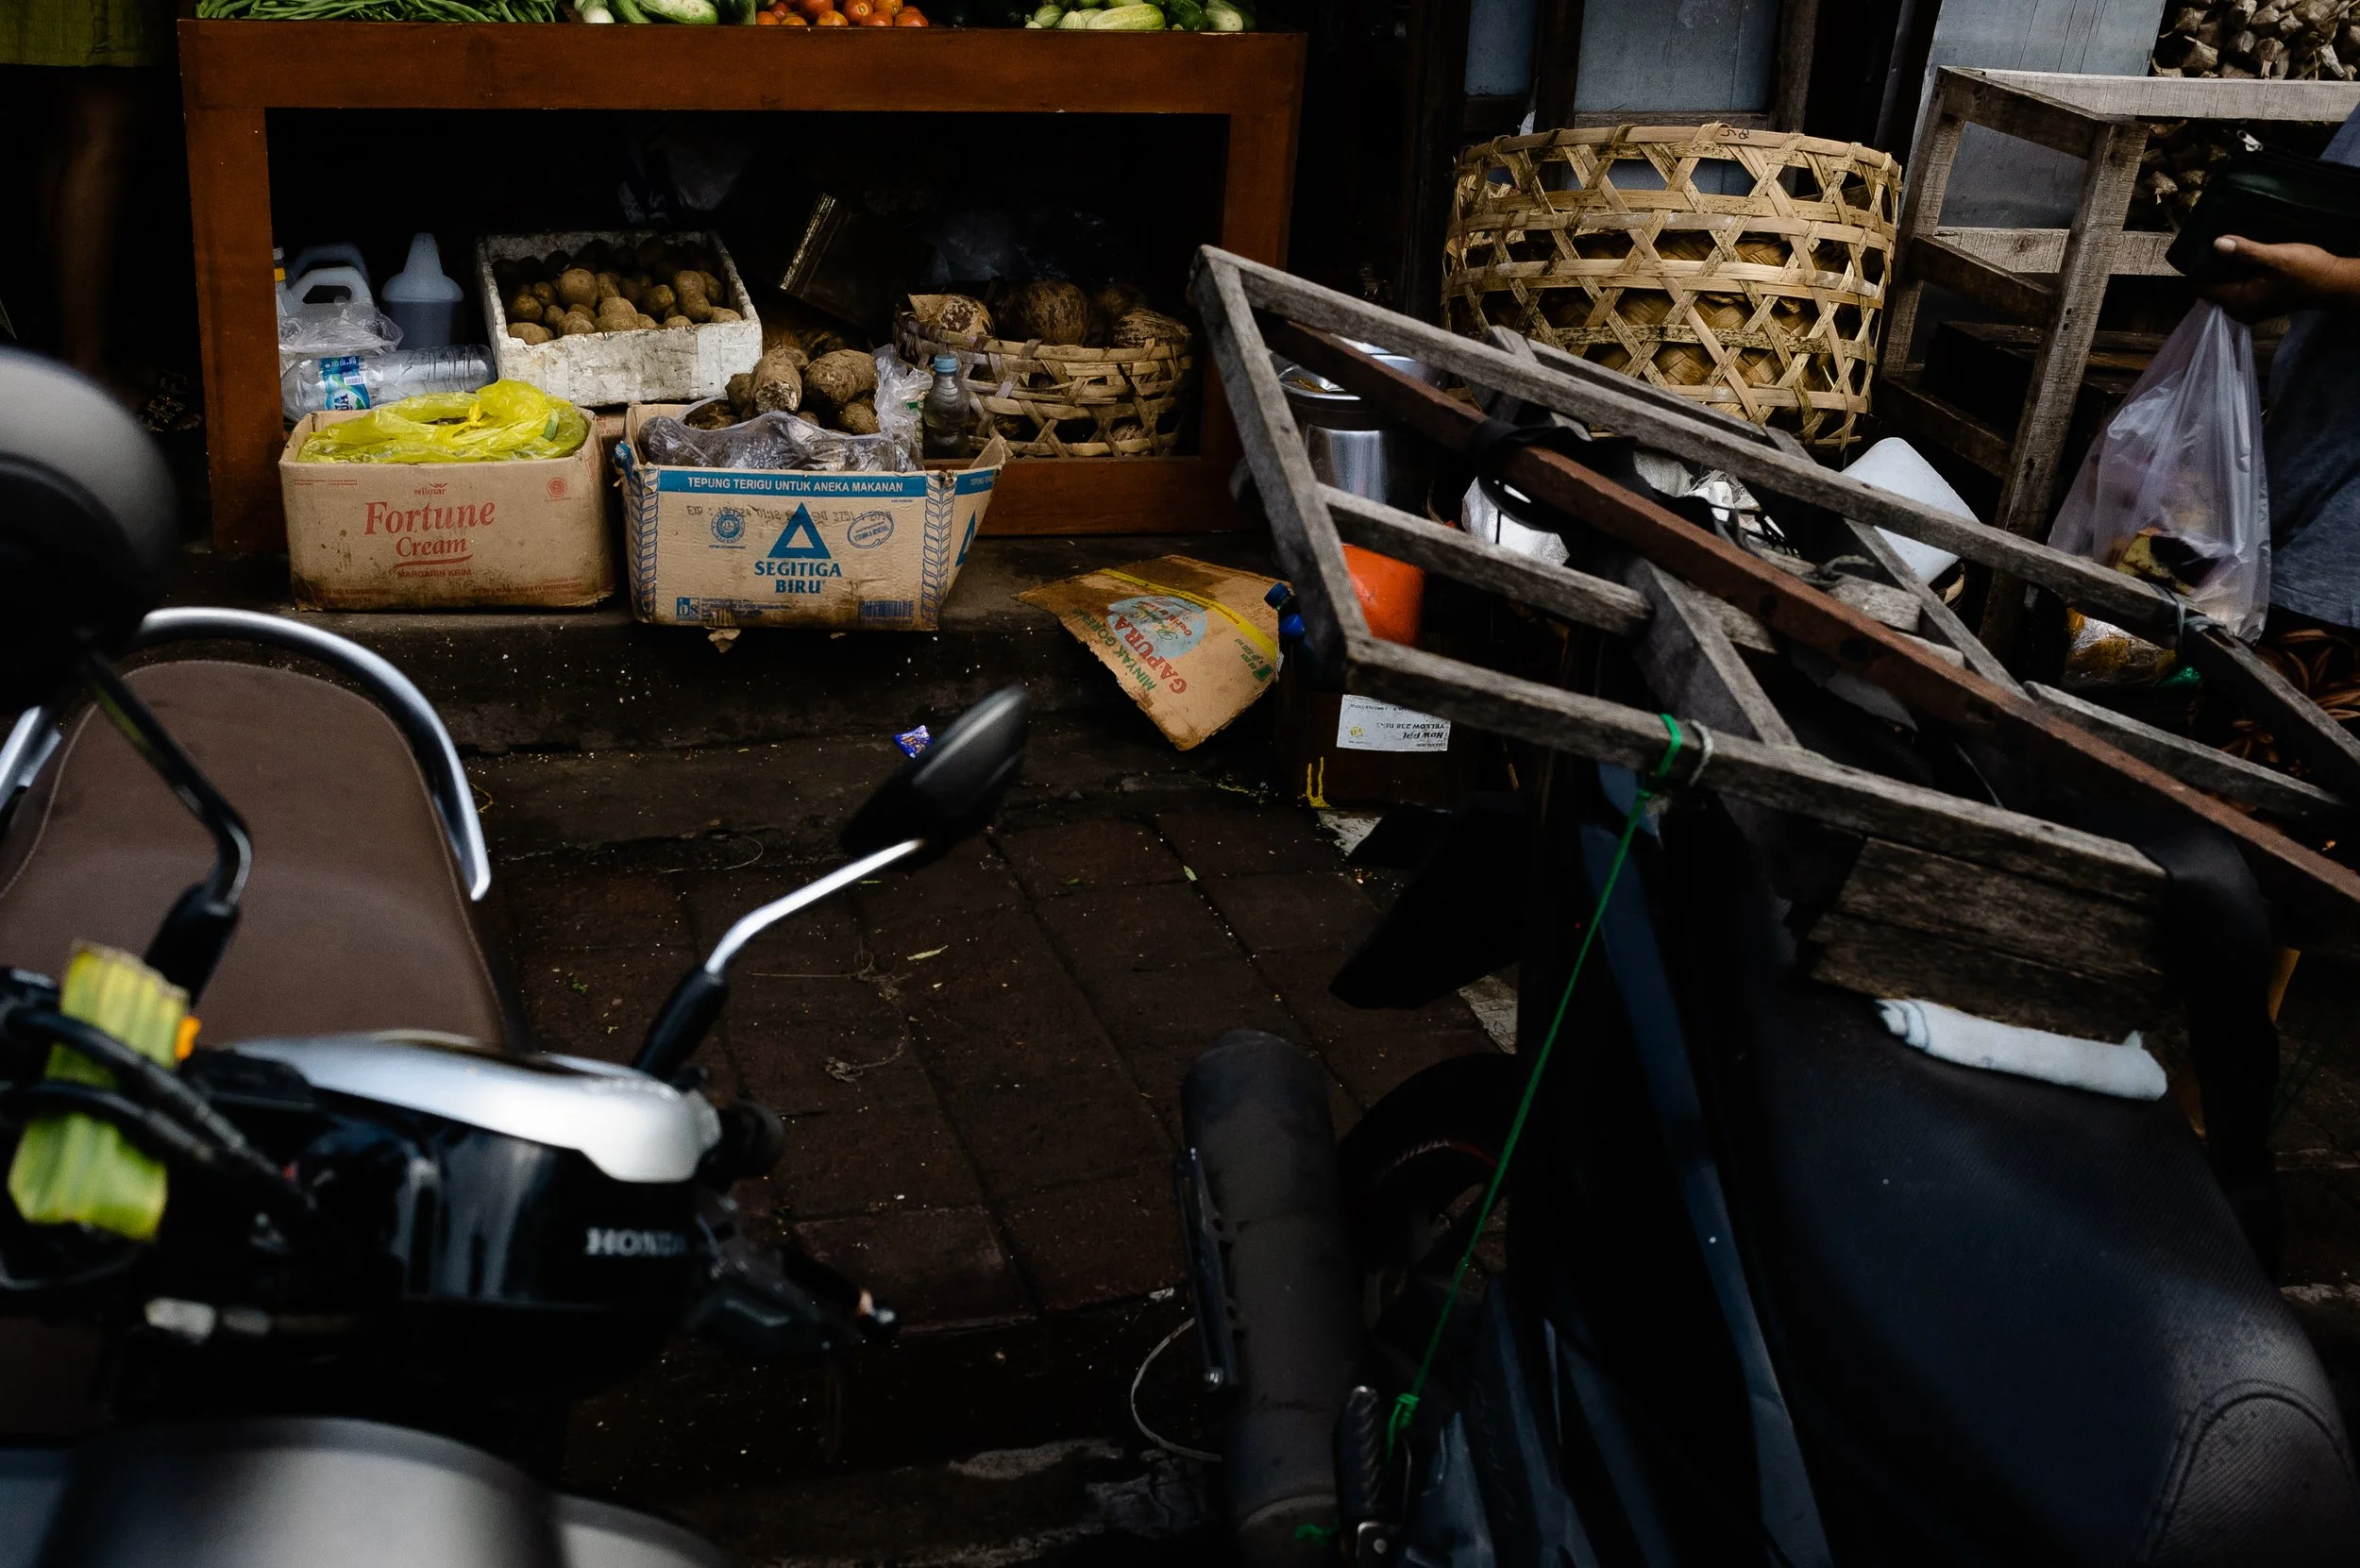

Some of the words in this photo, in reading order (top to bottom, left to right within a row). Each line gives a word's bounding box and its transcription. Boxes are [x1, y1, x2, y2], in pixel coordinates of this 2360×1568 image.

[413, 486, 447, 496] wilmar
[687, 477, 731, 488] TEPUNG
[733, 479, 772, 490] TERIGU
[775, 480, 811, 491] UNTUK
[814, 481, 850, 492] ANEKA
[851, 481, 903, 492] MAKANAN
[363, 501, 496, 535] Fortune
[396, 536, 468, 557] Cream
[754, 561, 842, 577] SEGITIGA
[775, 579, 821, 594] BIRU
[1115, 614, 1188, 694] GAPURA
[1113, 645, 1157, 691] MINYAK
